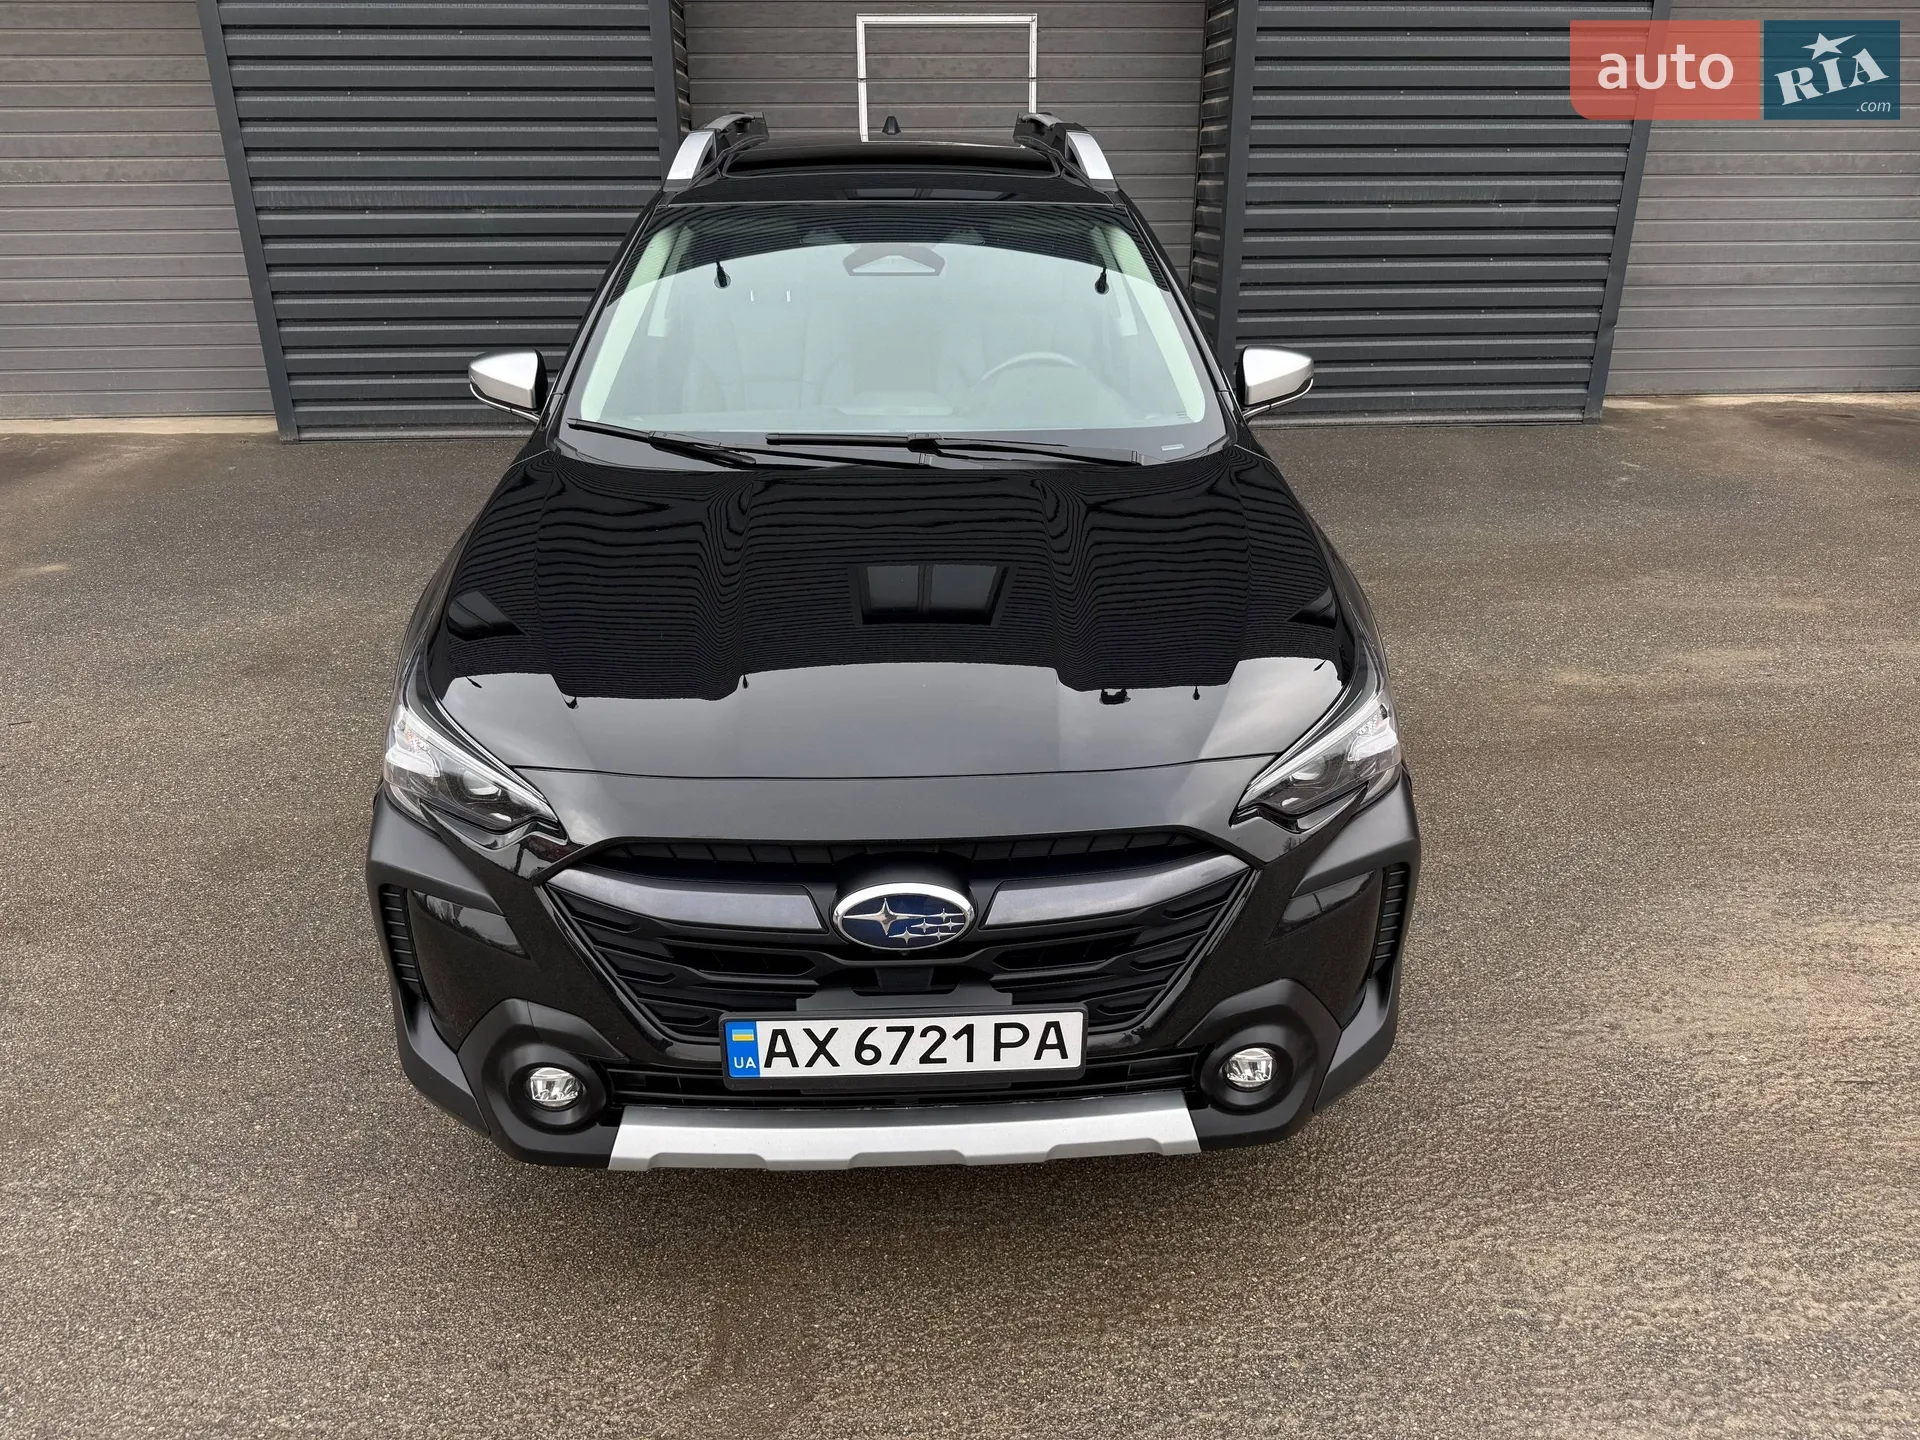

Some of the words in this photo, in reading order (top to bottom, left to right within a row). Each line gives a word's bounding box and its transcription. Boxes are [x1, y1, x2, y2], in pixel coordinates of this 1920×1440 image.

[763, 1027, 841, 1068] AX
[854, 1023, 975, 1066] 6721
[993, 1020, 1069, 1062] PA
[733, 1056, 757, 1069] UA
